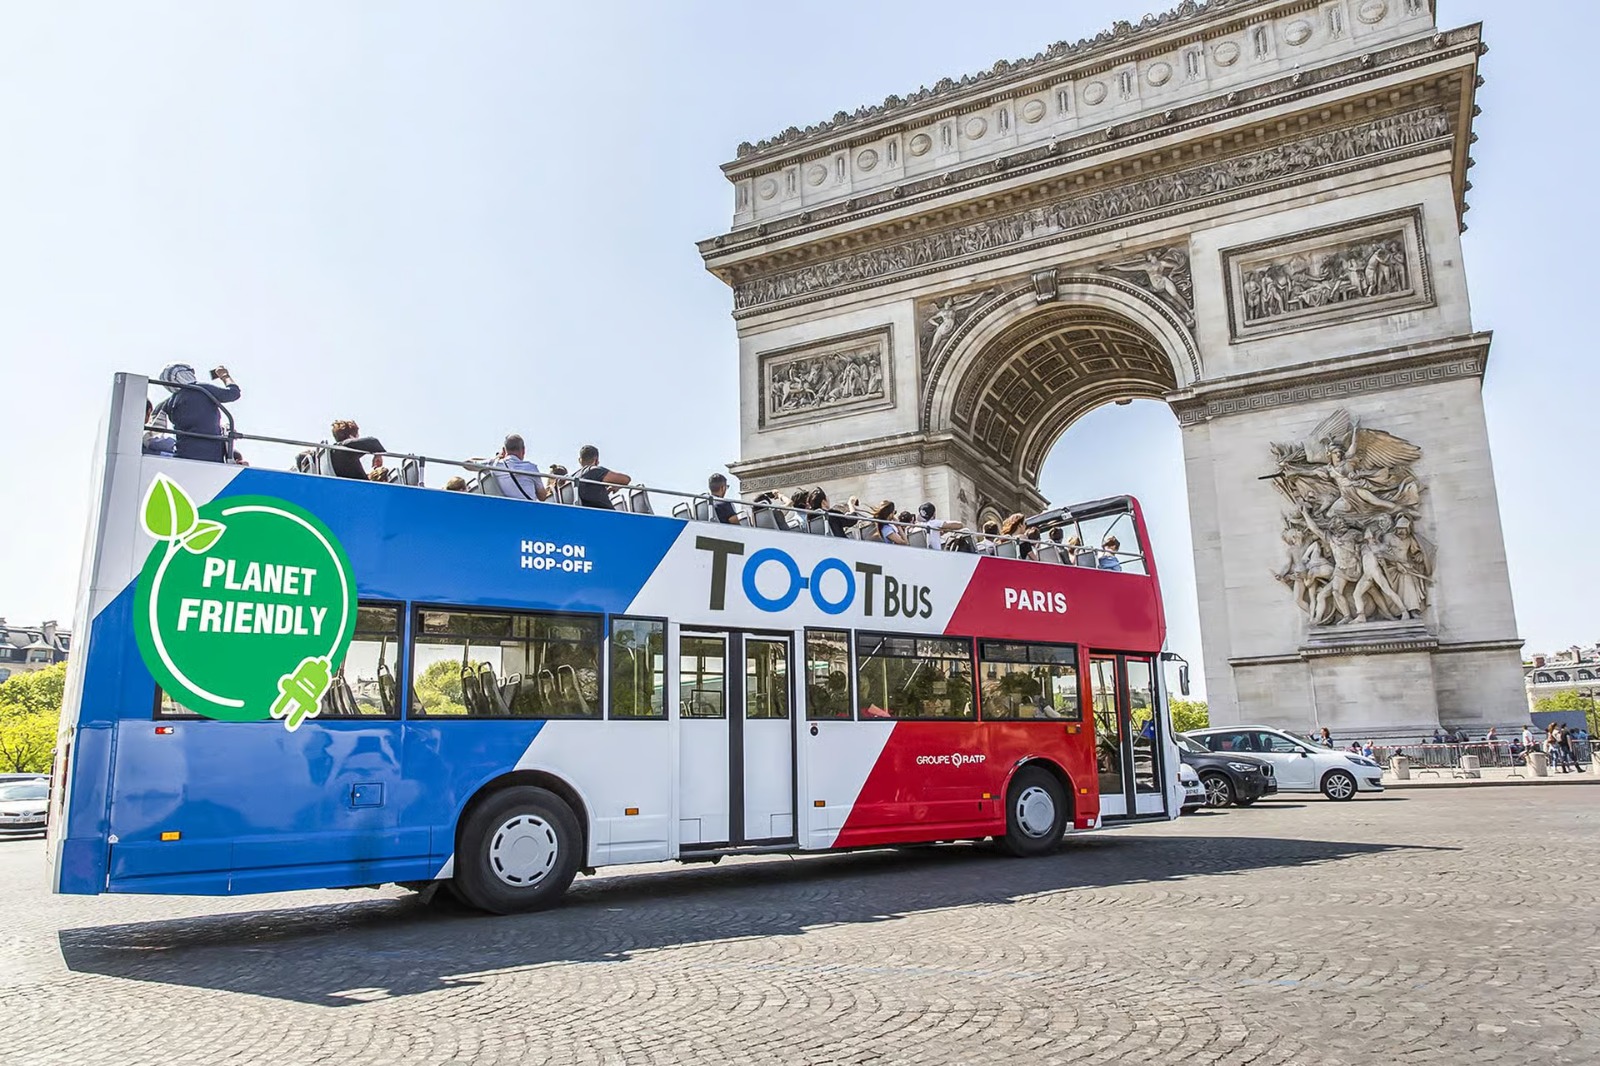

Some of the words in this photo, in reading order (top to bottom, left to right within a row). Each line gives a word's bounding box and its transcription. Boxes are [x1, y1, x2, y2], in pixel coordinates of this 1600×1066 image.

[521, 540, 585, 558] HOP-ON
[521, 555, 593, 573] HOP-OFF
[202, 556, 317, 596] PLANET
[1004, 587, 1068, 614] PARIS
[176, 598, 328, 636] FRIENDLY
[916, 755, 951, 765] GROUPE
[962, 754, 986, 764] RATP
